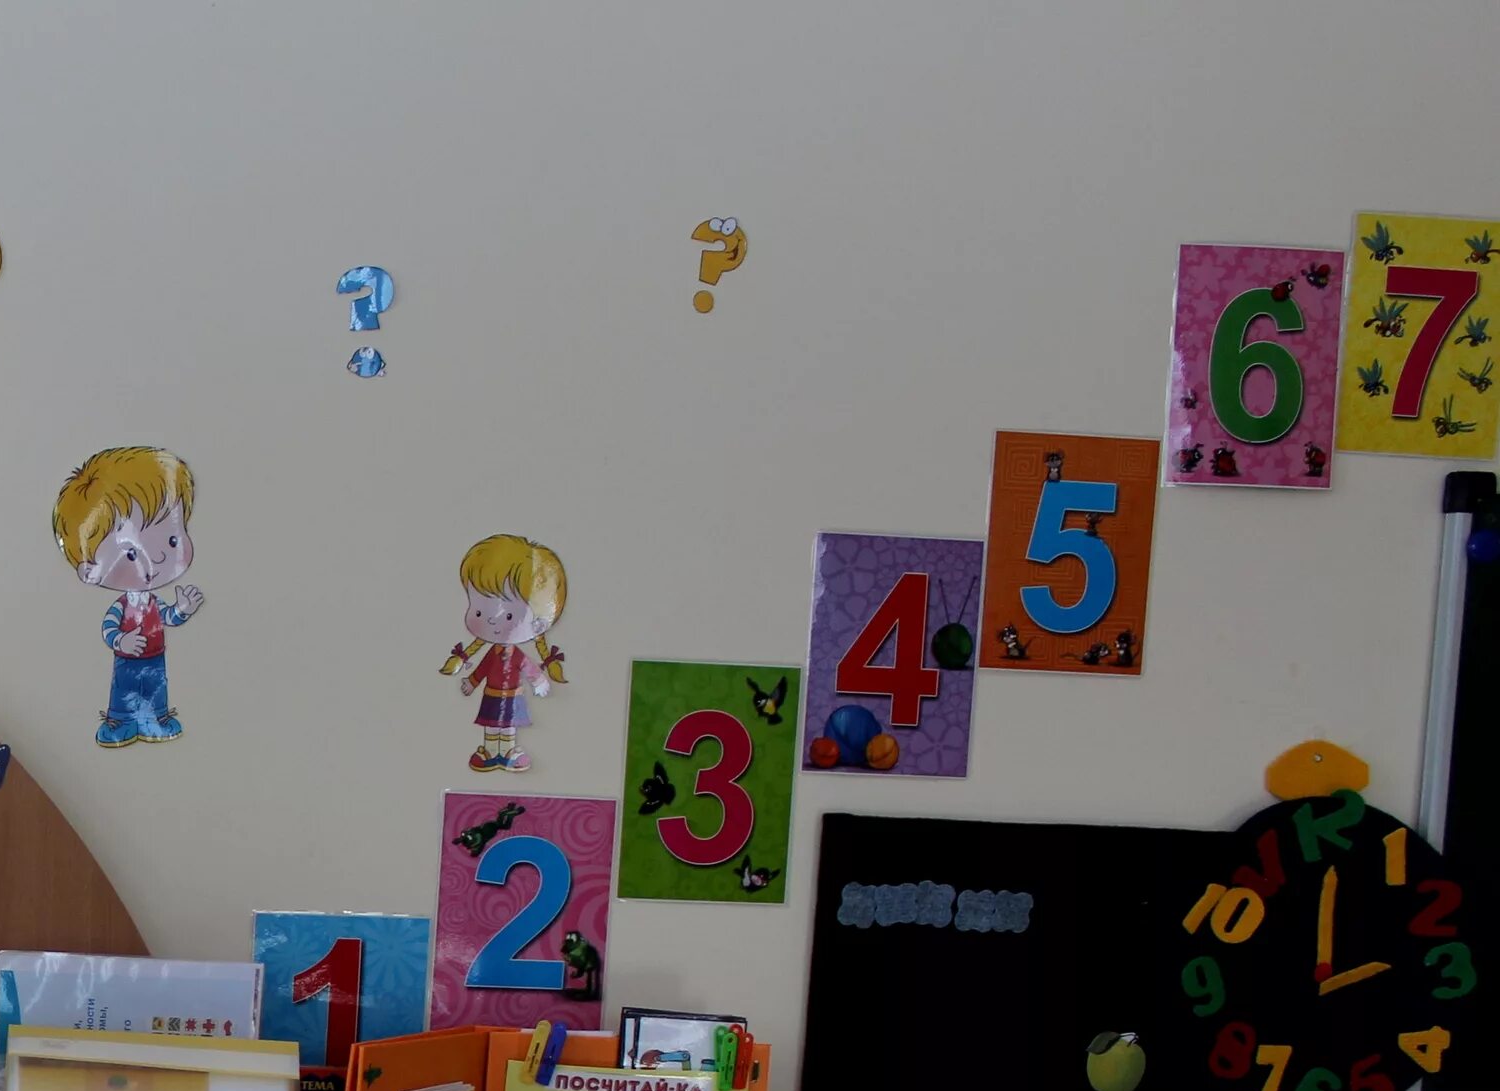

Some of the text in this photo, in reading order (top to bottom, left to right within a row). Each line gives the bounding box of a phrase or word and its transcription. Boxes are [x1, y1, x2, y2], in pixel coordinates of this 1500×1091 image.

[1206, 287, 1307, 444] 6
[1383, 265, 1480, 420] 7
[1019, 479, 1118, 634] 5
[834, 571, 940, 728] 4
[655, 708, 757, 867] 3
[1382, 826, 1410, 887] 1
[464, 833, 574, 990] 2
[1182, 883, 1265, 944] 10
[1406, 877, 1465, 939] 2
[293, 938, 362, 1066] 1
[1181, 953, 1227, 1019] 9
[1422, 940, 1479, 1002] 3
[1209, 1020, 1258, 1081] 8
[1397, 1025, 1452, 1074] 4
